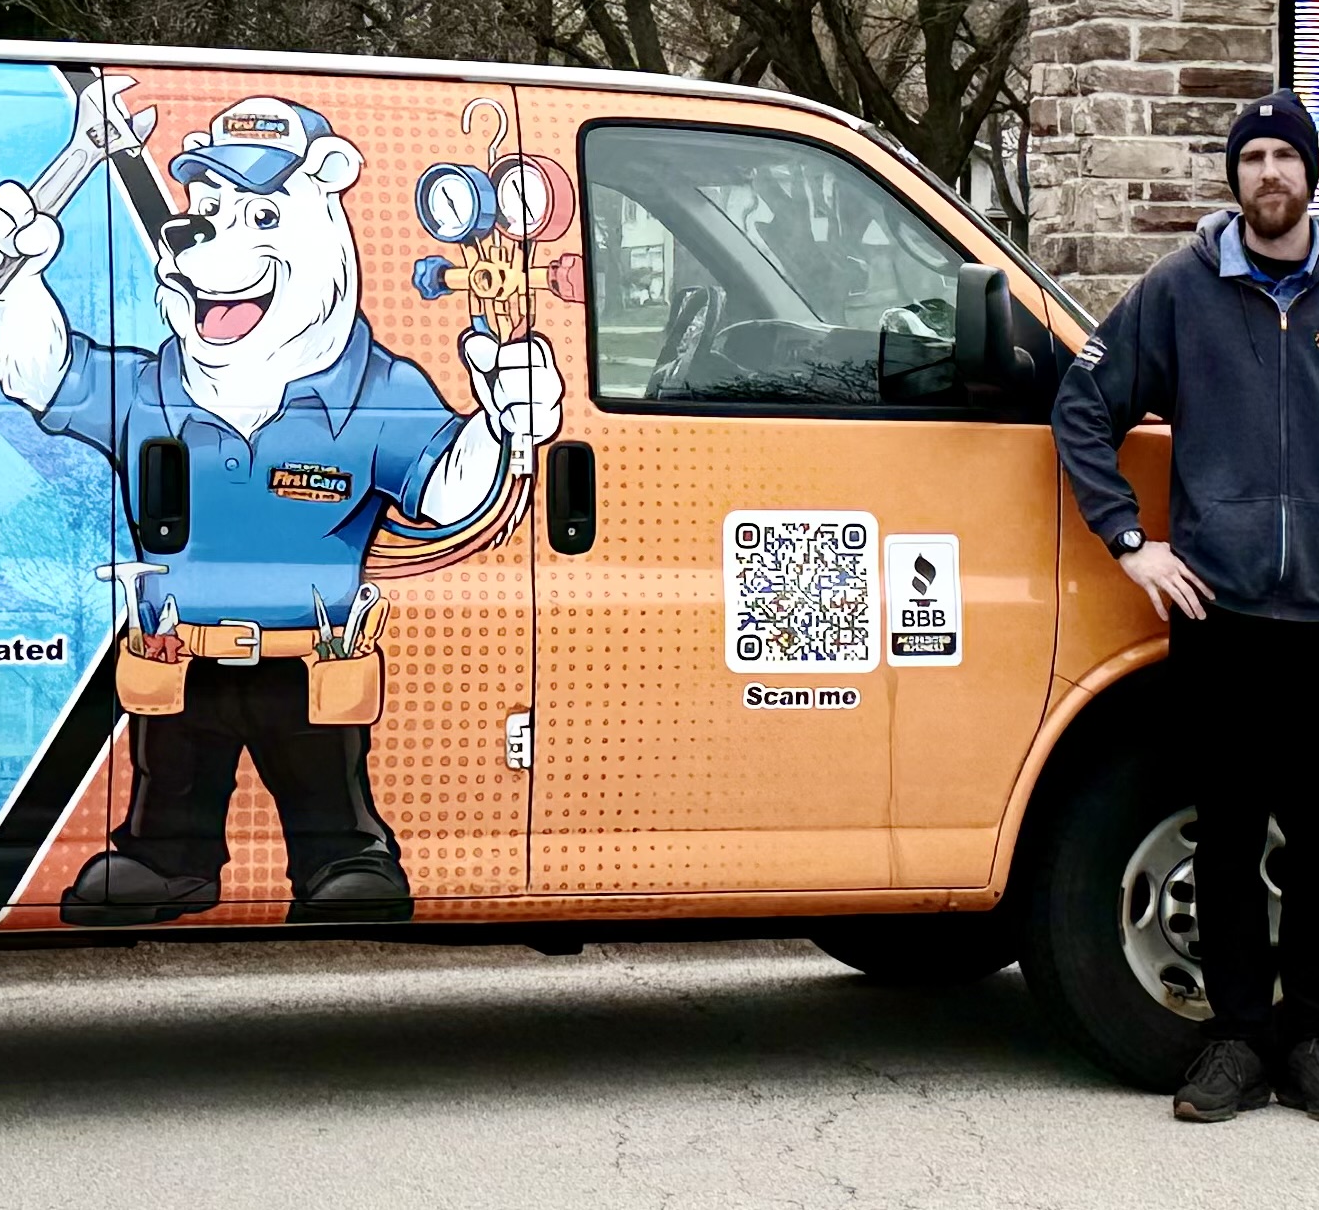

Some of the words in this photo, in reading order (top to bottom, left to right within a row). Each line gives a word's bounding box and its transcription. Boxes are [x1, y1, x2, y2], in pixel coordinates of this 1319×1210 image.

[901, 609, 947, 628] BBB
[746, 686, 810, 706] Scan
[819, 690, 857, 706] me
